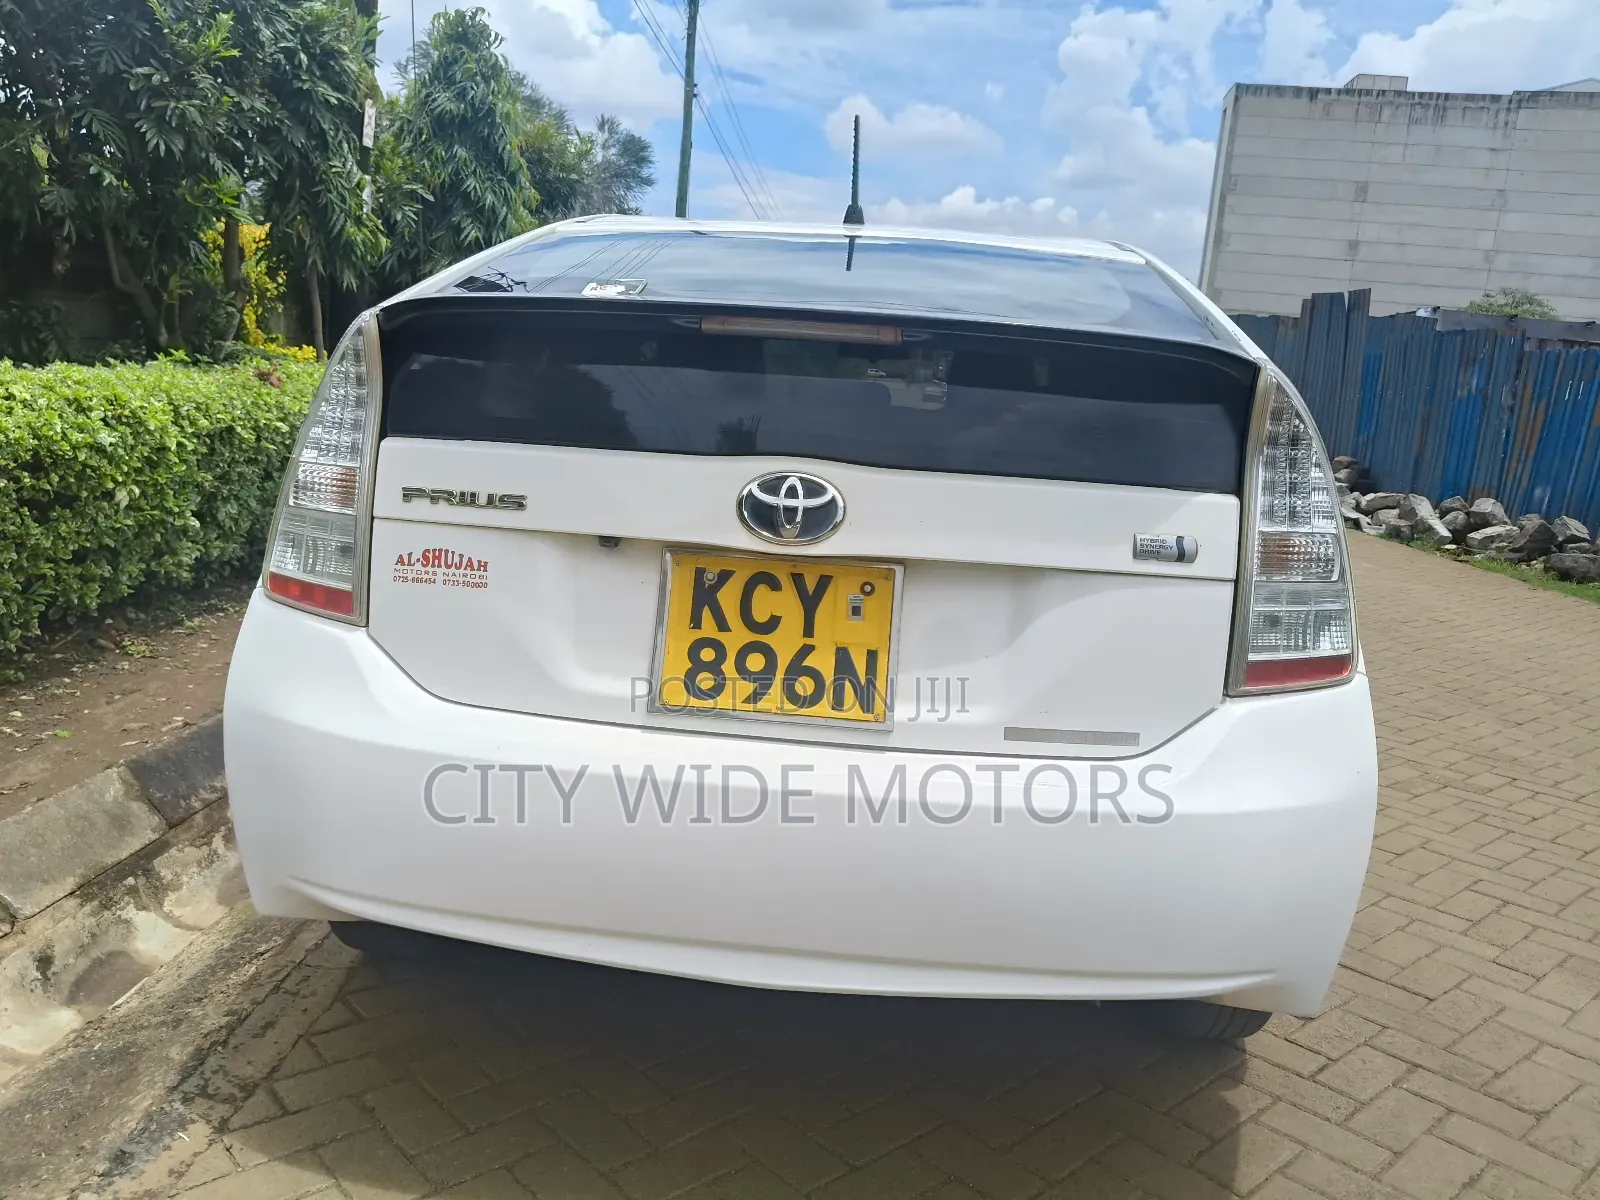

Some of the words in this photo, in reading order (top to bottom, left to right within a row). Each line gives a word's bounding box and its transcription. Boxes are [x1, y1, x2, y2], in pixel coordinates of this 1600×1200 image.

[401, 486, 528, 511] PRIUS
[394, 548, 489, 572] AL-SHUJAH
[393, 568, 438, 577] MOTORS
[442, 571, 488, 581] NAIROBI
[689, 566, 834, 639] KCY
[684, 637, 878, 715] 896N
